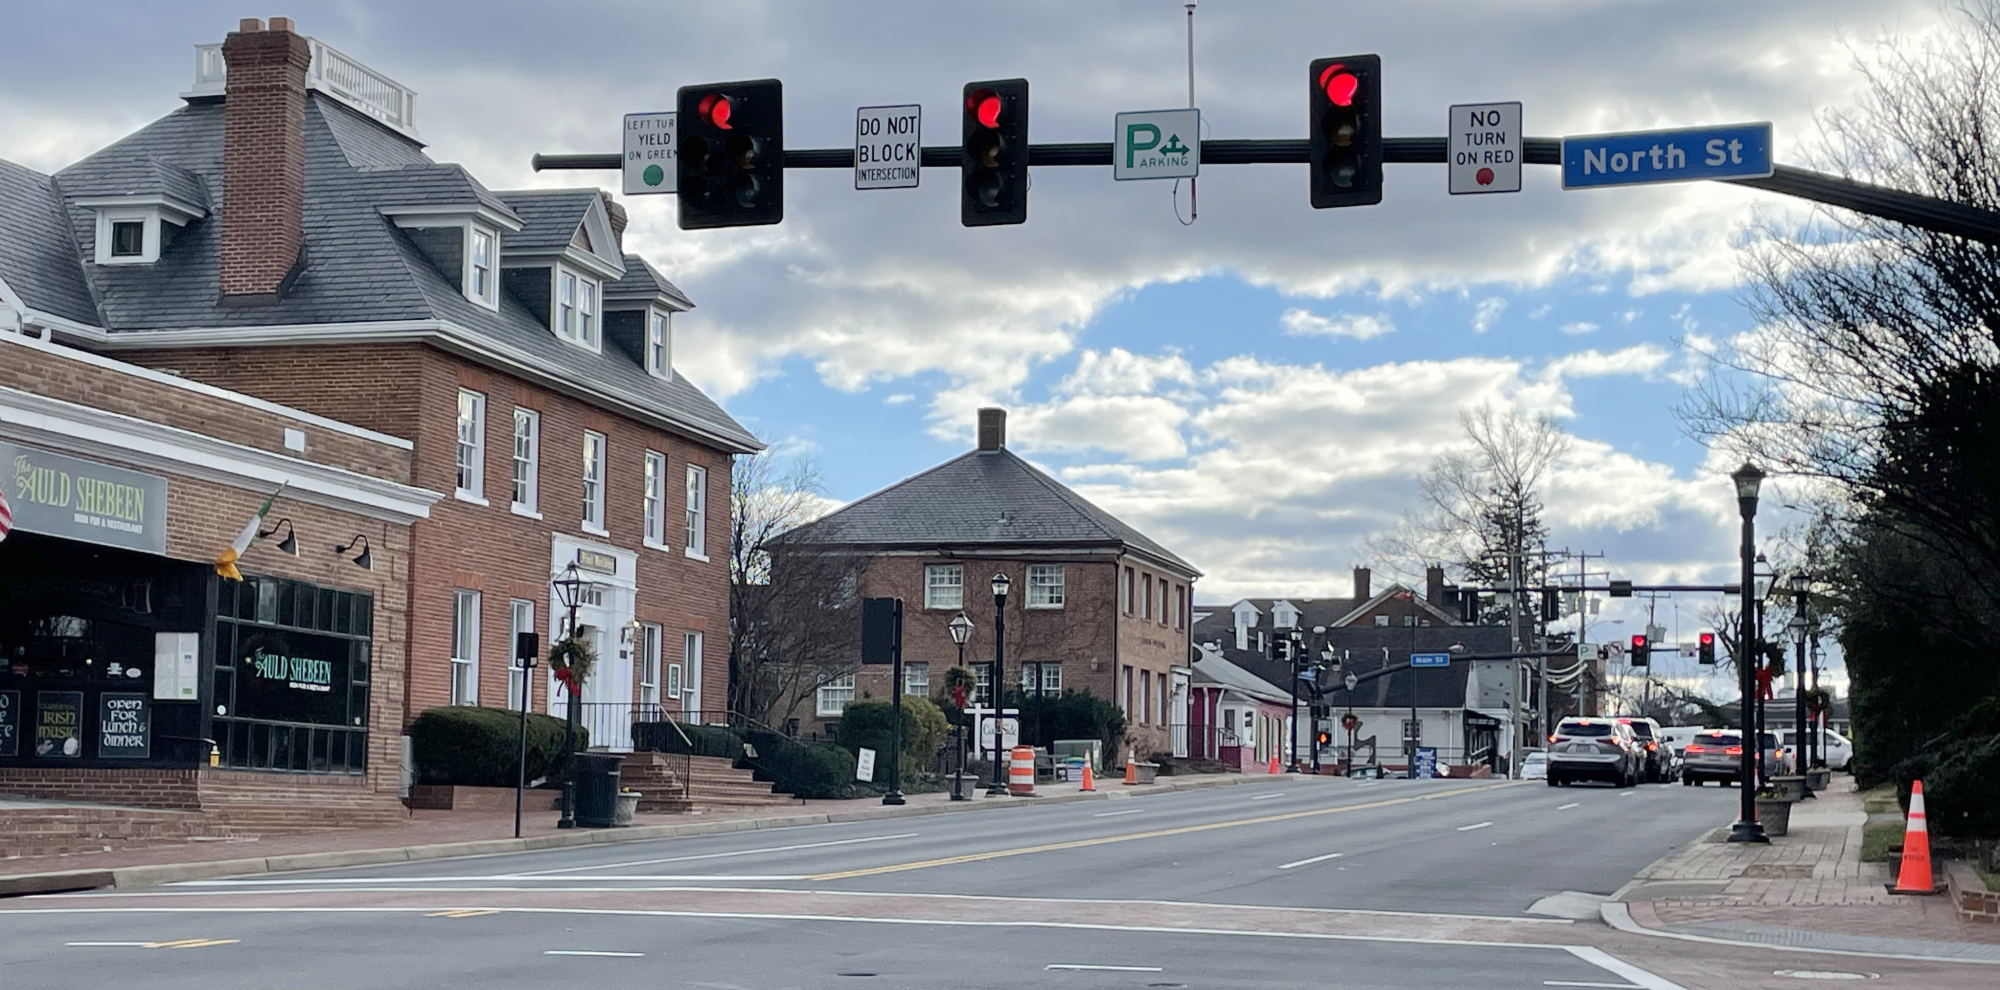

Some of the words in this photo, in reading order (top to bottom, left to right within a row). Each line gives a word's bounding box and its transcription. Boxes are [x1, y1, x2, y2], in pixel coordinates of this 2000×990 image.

[627, 120, 650, 131] LEFT
[656, 118, 675, 129] TUR
[860, 118, 881, 136] DO
[887, 115, 917, 135] NOT
[1471, 110, 1501, 128] NO
[638, 132, 671, 146] YIELD
[1464, 131, 1506, 147] TURN
[629, 150, 642, 161] ON
[859, 142, 916, 163] BLOCK
[1456, 151, 1478, 166] ON
[1484, 149, 1515, 165] RED
[1584, 143, 1686, 176] North
[1705, 137, 1744, 167] St
[858, 167, 916, 182] INTERSECTION
[13, 454, 32, 478] The
[17, 467, 71, 507] AULD
[76, 477, 145, 522] SHEBEEN
[1415, 656, 1433, 664] Main
[1435, 655, 1444, 664] St
[254, 654, 288, 680] AULD
[289, 657, 332, 684] SHEBEEN
[110, 710, 138, 722] FOR
